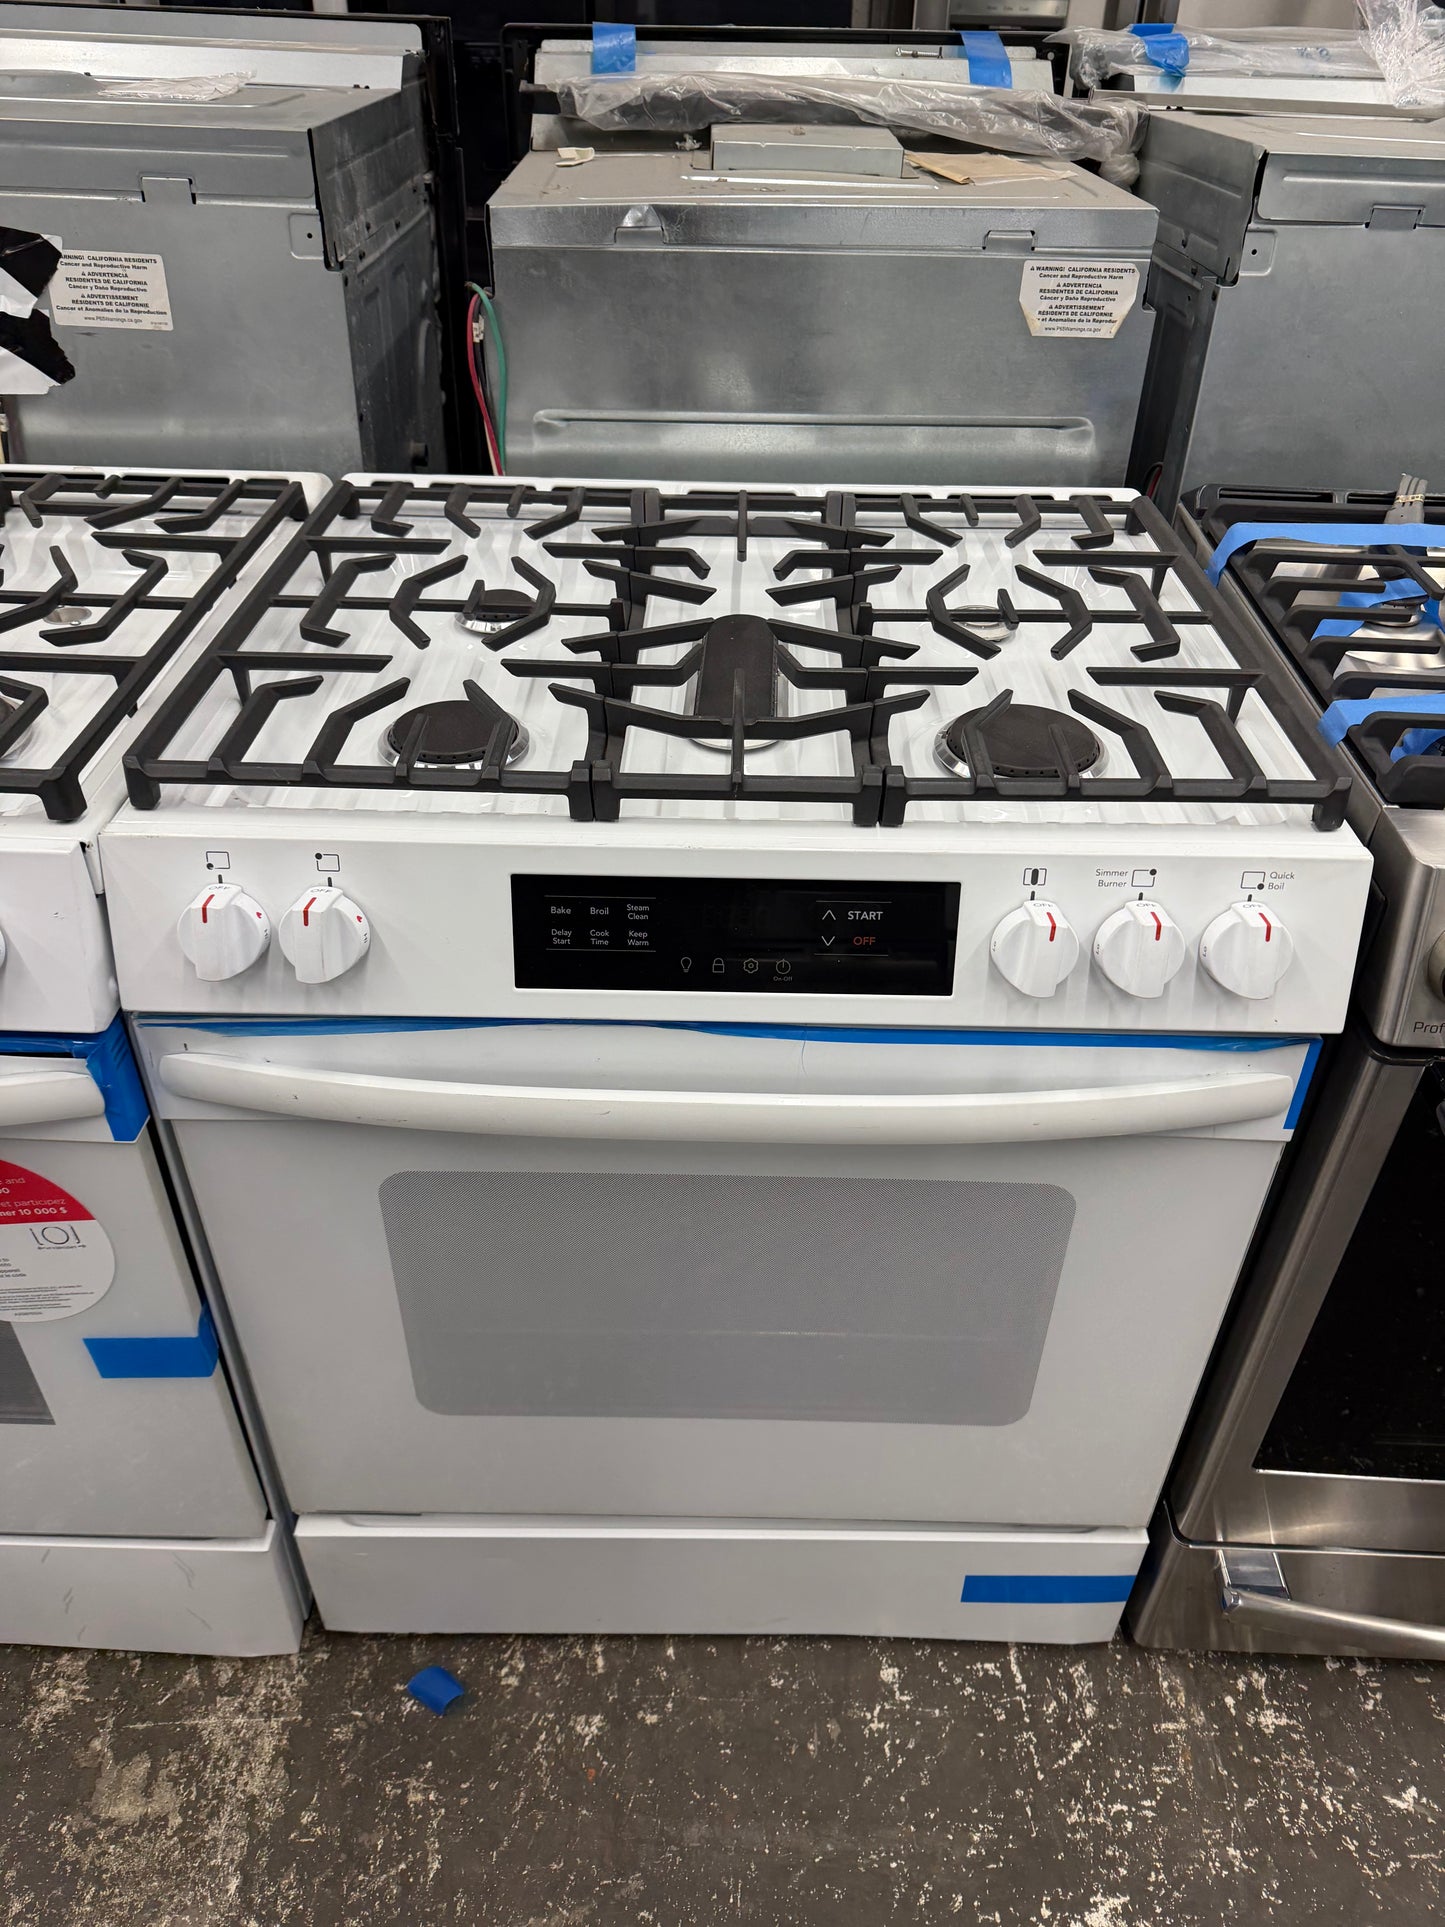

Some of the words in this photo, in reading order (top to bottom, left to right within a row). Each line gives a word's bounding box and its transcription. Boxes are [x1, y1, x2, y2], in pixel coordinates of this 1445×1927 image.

[1095, 868, 1128, 878] Simmer
[1269, 871, 1295, 881] Quick
[1098, 879, 1127, 888] Burner
[1268, 882, 1285, 890] Boil
[550, 906, 571, 914] Bake
[590, 907, 609, 915] Broil
[847, 911, 883, 921] START
[551, 929, 572, 938] Delay
[628, 930, 648, 939] Keep
[853, 936, 876, 946] OFF
[1413, 1022, 1445, 1033] Prof
